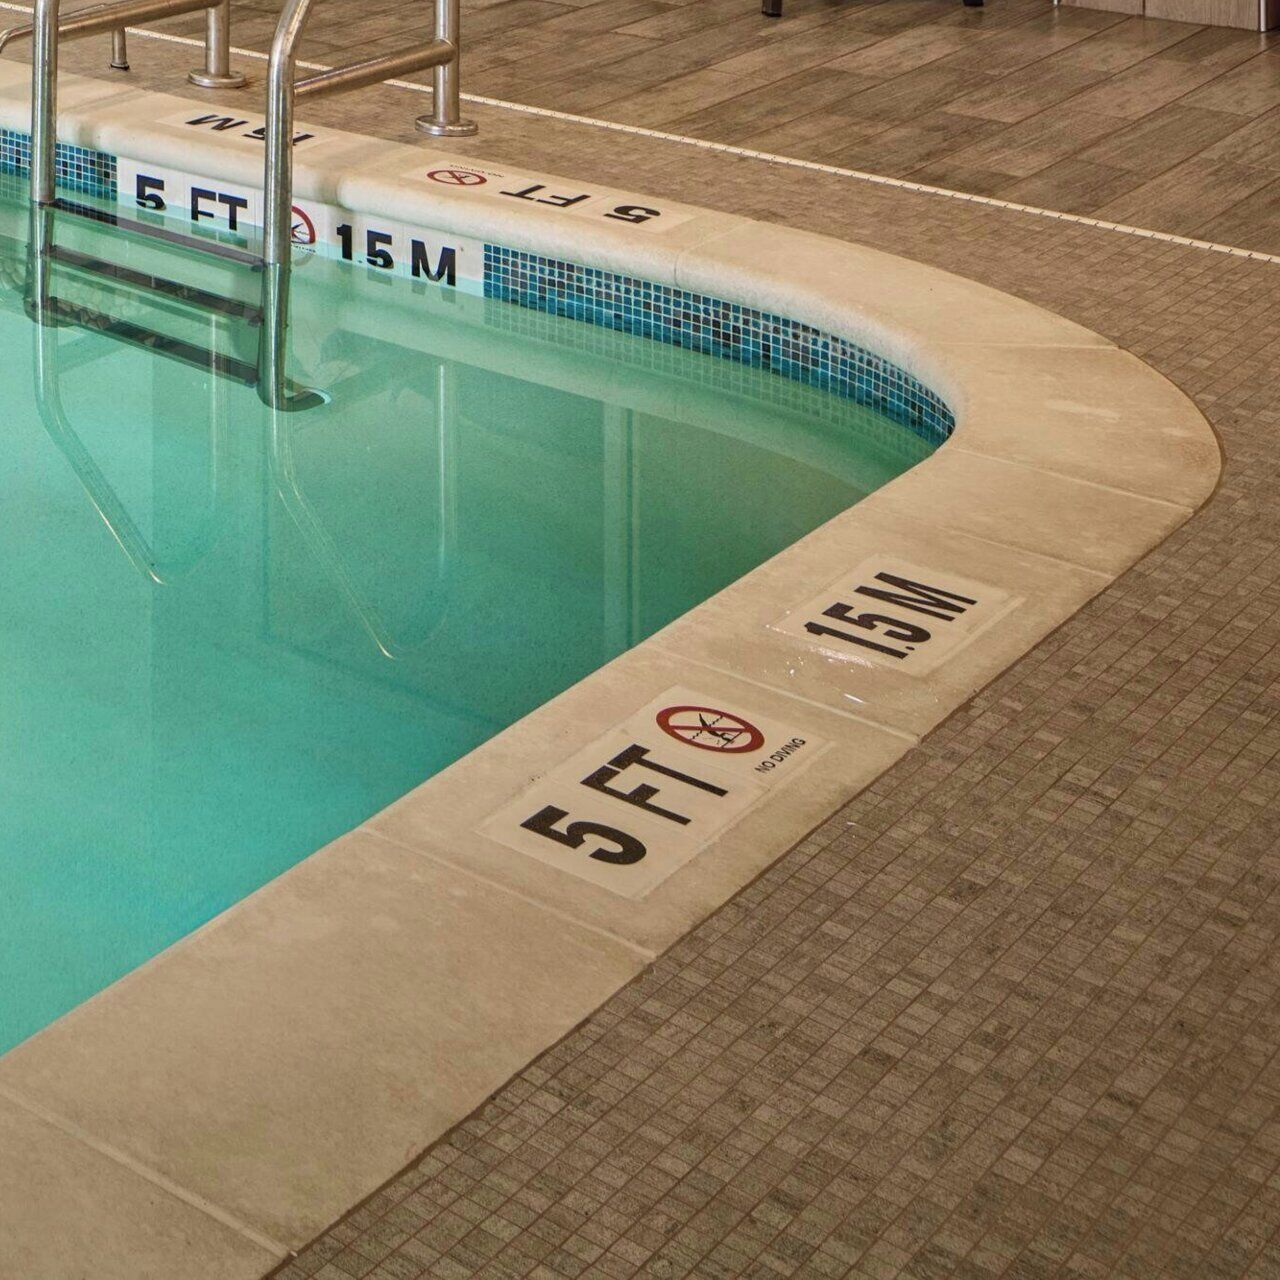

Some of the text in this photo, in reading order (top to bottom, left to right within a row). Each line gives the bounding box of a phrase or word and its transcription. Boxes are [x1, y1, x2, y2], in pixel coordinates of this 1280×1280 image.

[136, 173, 166, 210] 5
[191, 186, 248, 231] FT
[499, 184, 661, 224] 5 FT
[754, 738, 806, 773] NO DIVING
[520, 743, 729, 865] 5 FT
